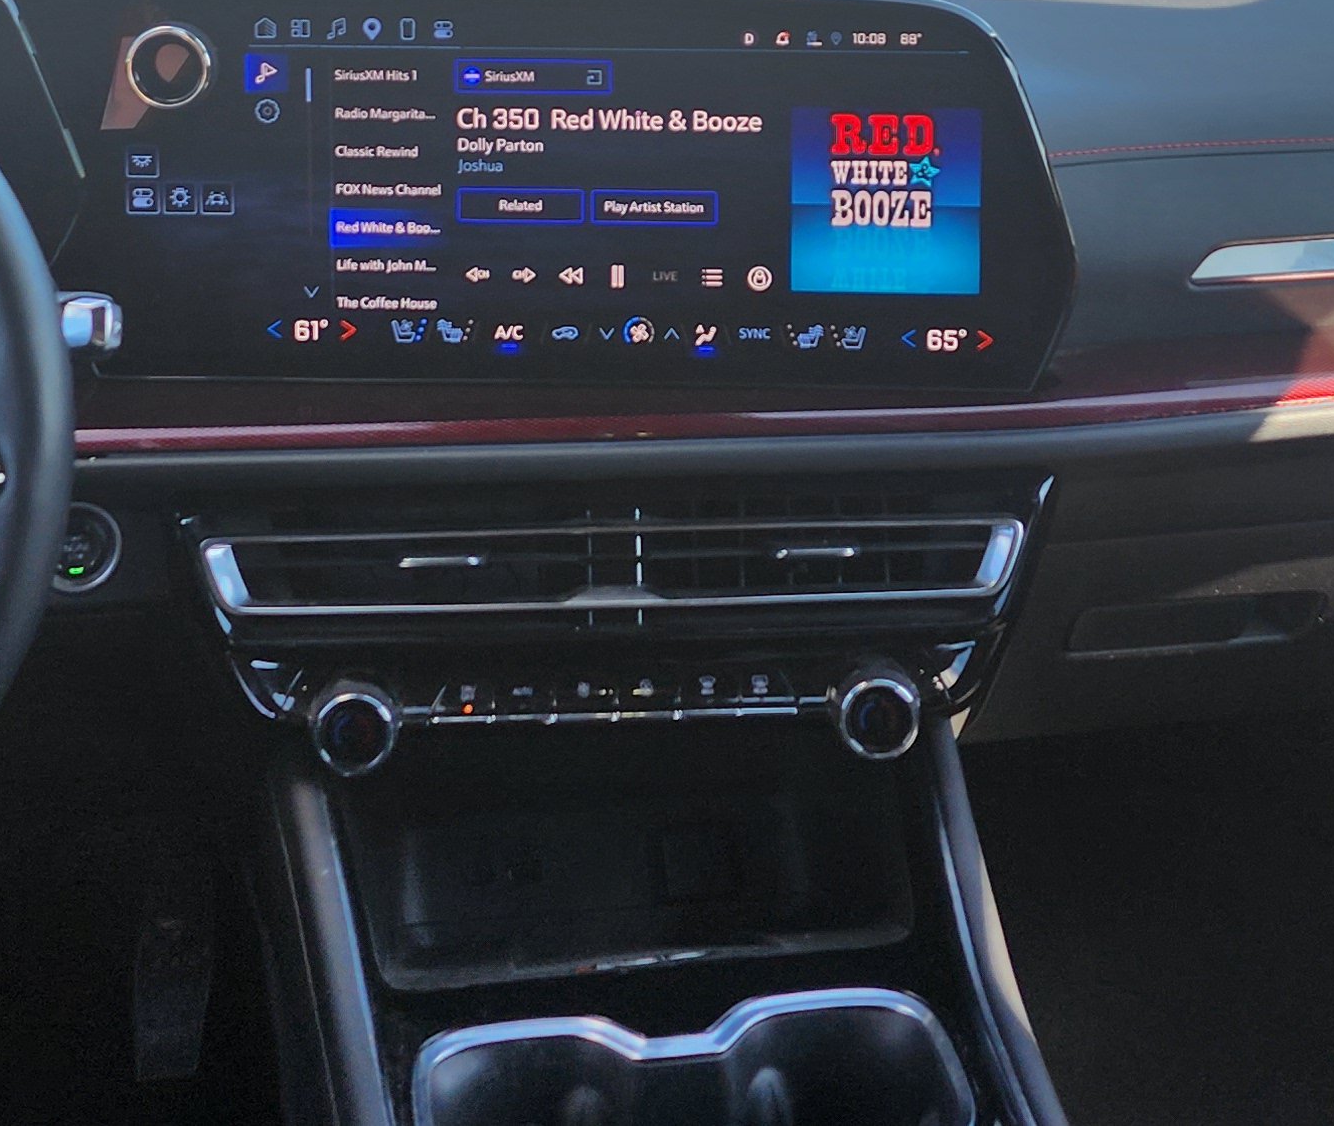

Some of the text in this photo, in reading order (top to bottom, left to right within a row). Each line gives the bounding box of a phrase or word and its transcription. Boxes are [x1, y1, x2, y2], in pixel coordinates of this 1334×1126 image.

[852, 32, 887, 45] 10:08
[334, 69, 384, 82] SiriusXM
[386, 69, 409, 82] Hits
[484, 70, 536, 84] SiriusXM
[334, 107, 368, 121] Radio
[456, 107, 763, 134] Ch 350 Red White & Booze
[830, 113, 934, 156] RED
[334, 145, 419, 159] Classic Rewind
[457, 138, 544, 156] Dolly Parton
[458, 159, 504, 173] Joshua
[830, 159, 909, 186] WHITE
[335, 183, 443, 197] FOX News Channel
[498, 198, 544, 213] Related
[603, 199, 705, 216] Play Artist Station
[830, 190, 932, 228] BOOZE
[336, 220, 359, 235] Red
[359, 221, 394, 235] White
[395, 222, 406, 235] &
[336, 259, 359, 273] Life
[359, 259, 385, 273] with
[385, 259, 413, 274] John
[652, 270, 679, 283] LIVE
[336, 296, 438, 312] The Coffee House
[293, 318, 330, 342] 61°
[494, 323, 525, 341] A/C
[738, 326, 772, 341] SYNC
[925, 328, 968, 352] 65°
